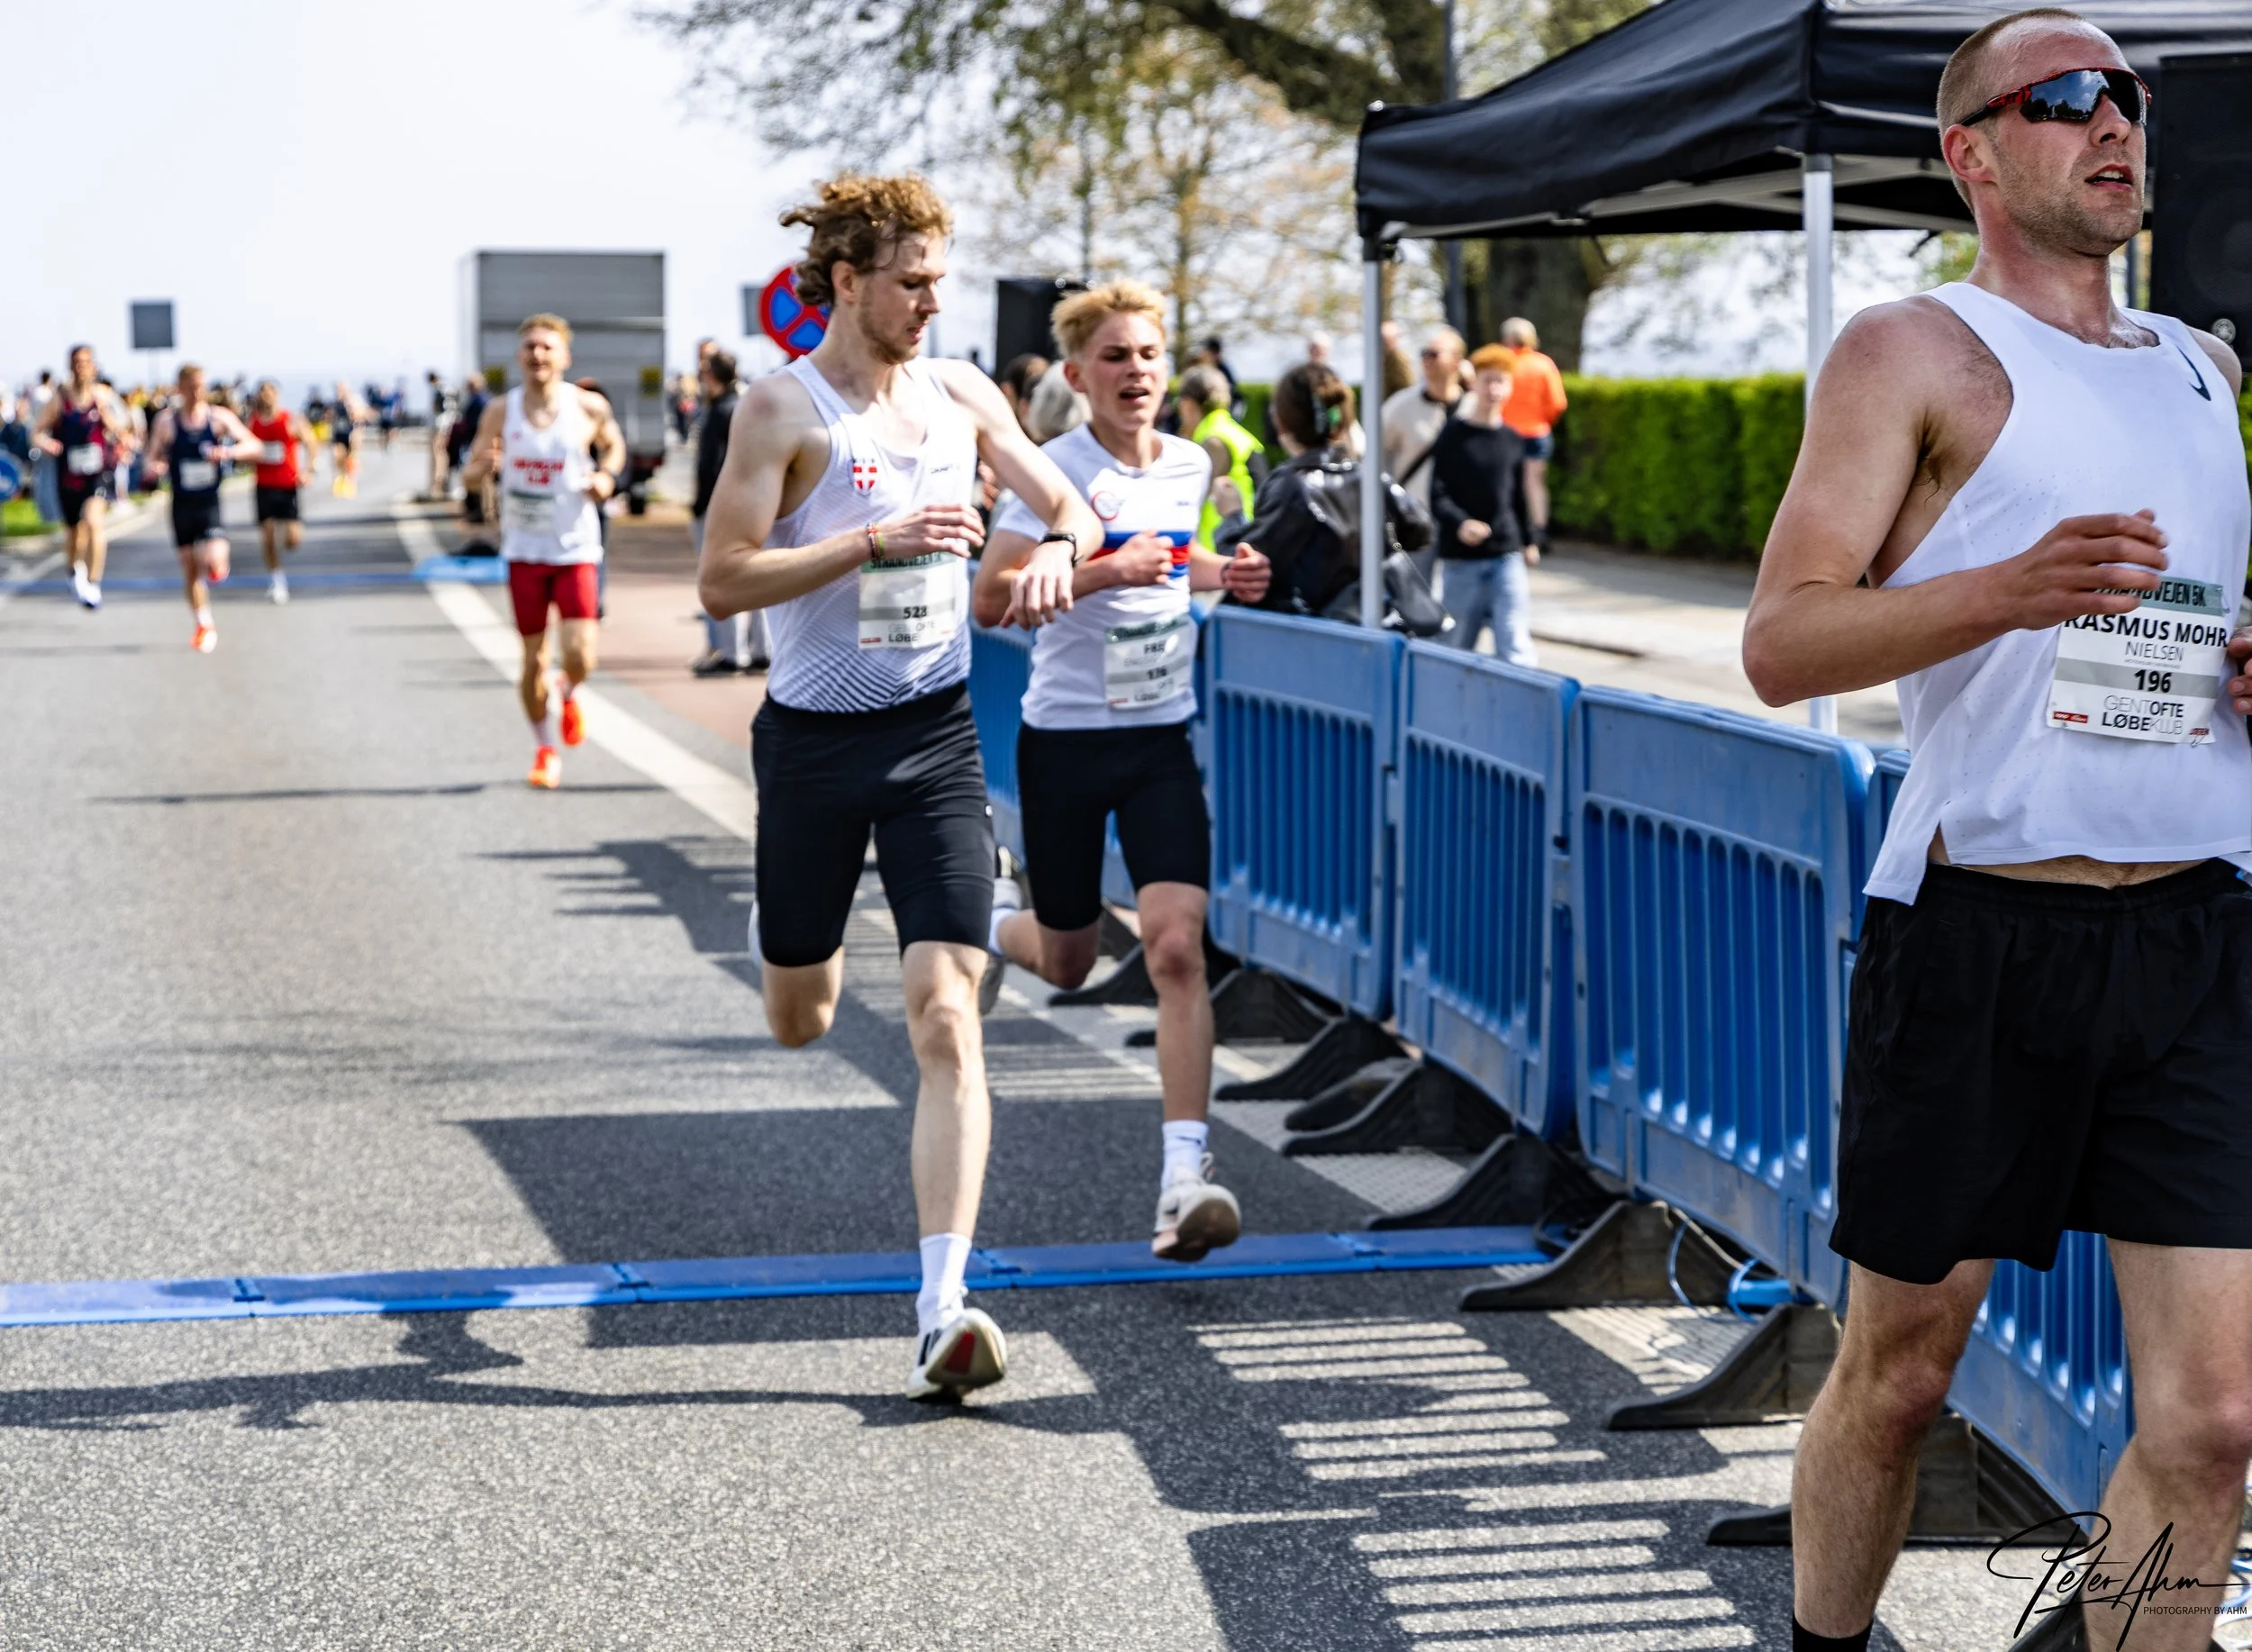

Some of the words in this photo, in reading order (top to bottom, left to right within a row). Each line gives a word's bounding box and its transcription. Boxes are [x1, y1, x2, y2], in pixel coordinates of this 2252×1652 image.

[2065, 614, 2170, 640] RASMUS
[2175, 622, 2228, 648] MOHR
[2125, 641, 2184, 662] NIELSEN
[2133, 668, 2172, 693] 196
[2103, 694, 2184, 718] GENTOFTE
[2102, 712, 2183, 735] LØBEKLUB
